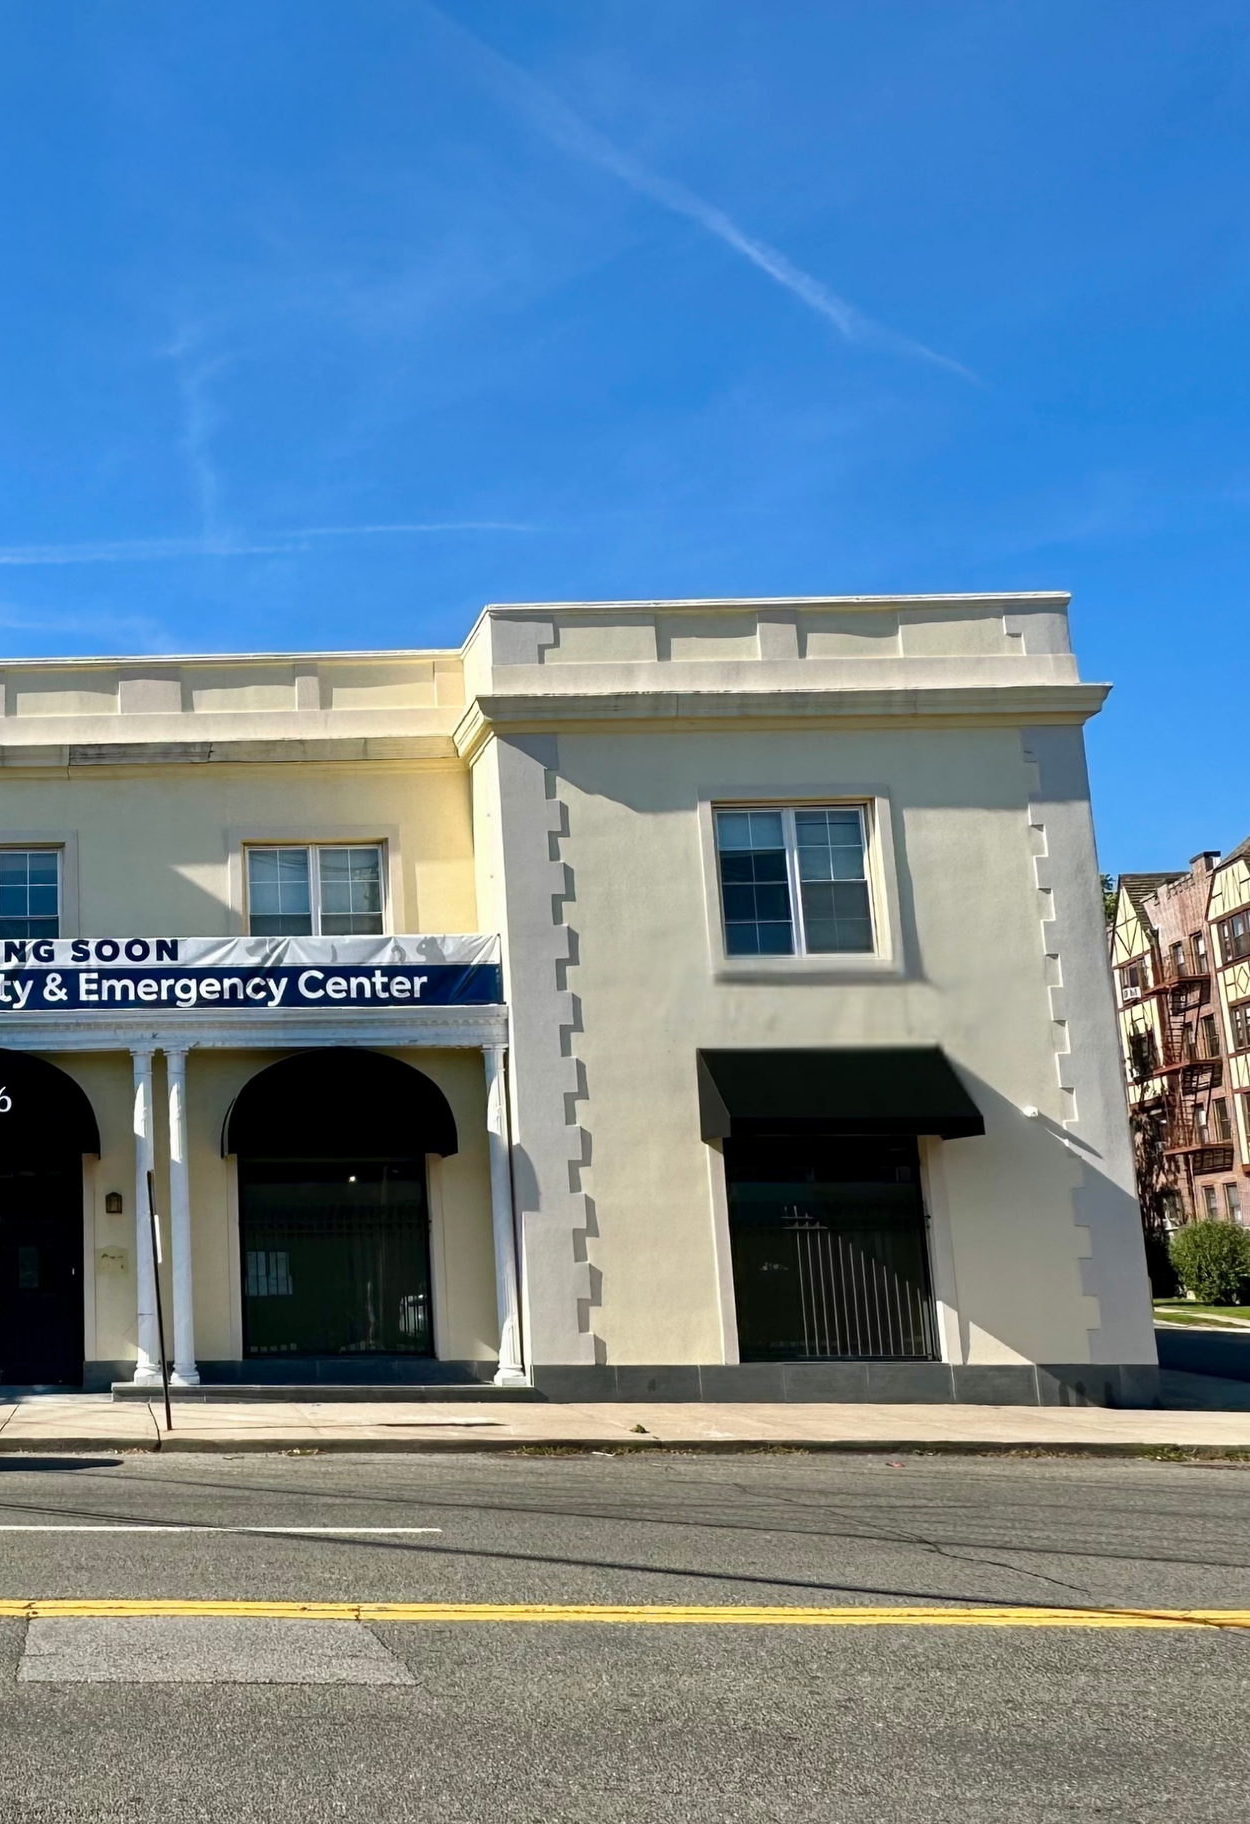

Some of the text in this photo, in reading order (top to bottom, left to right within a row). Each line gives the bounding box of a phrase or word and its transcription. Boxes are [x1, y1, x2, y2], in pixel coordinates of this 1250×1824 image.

[71, 938, 179, 962] SOON
[43, 972, 69, 1002] &
[79, 972, 288, 1008] Emergency
[298, 970, 428, 999] Center
